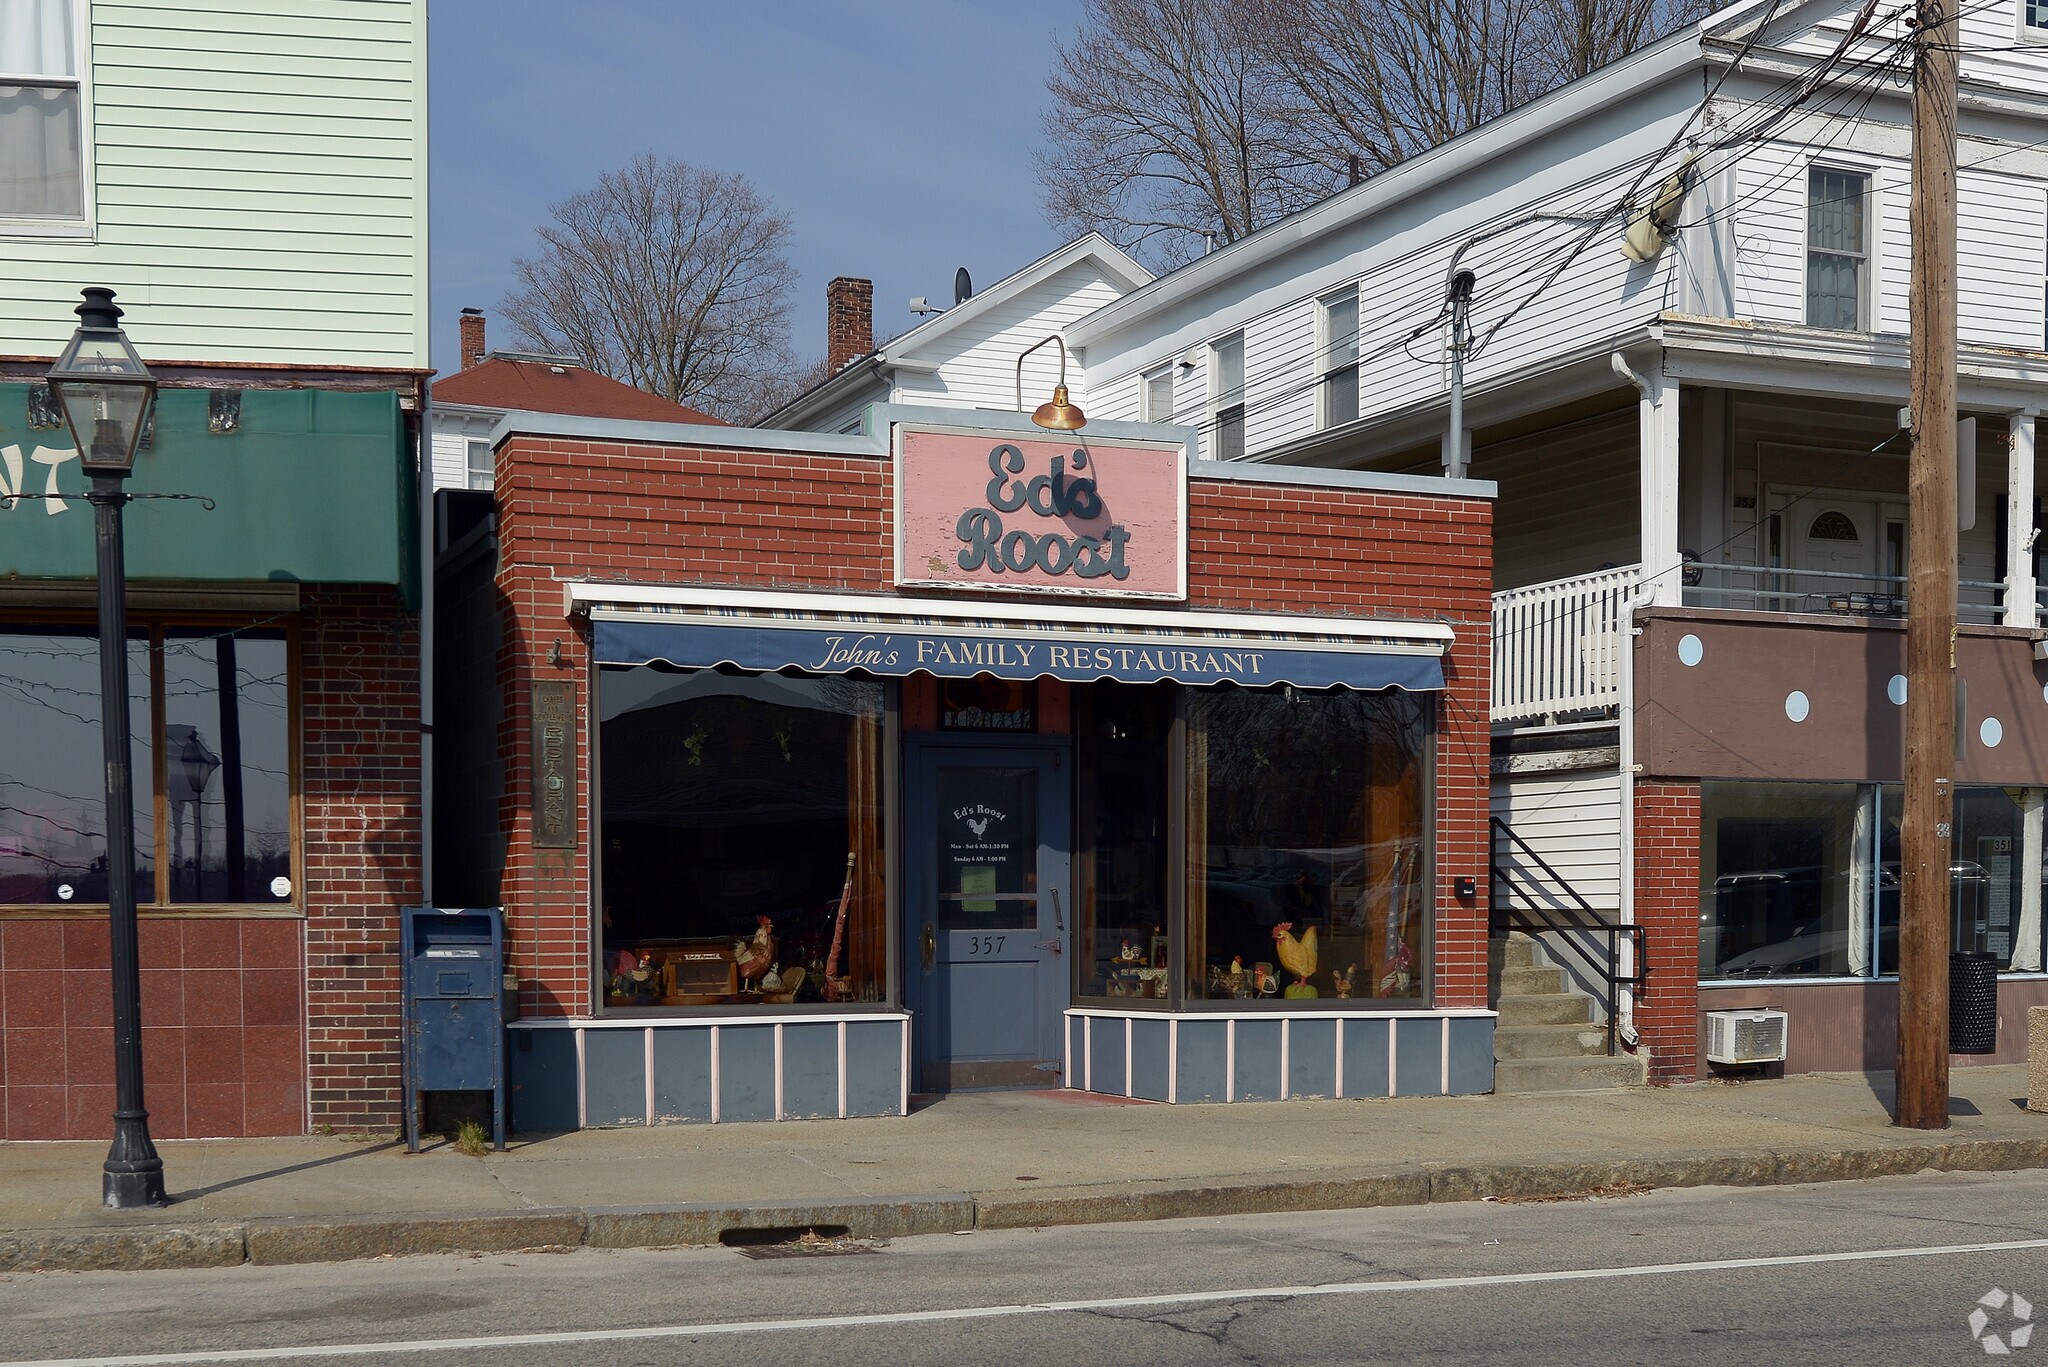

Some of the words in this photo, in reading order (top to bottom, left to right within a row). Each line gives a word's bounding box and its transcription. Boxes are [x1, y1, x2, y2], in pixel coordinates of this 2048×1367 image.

[986, 443, 1103, 520] Ed's
[955, 507, 1132, 580] Roost
[809, 635, 899, 670] John's
[916, 639, 1036, 668] FAMILY
[1049, 645, 1265, 674] RESTAURANT
[545, 726, 564, 834] RESTAURANT
[953, 805, 974, 821] Ed's
[977, 803, 1007, 822] Roost
[954, 855, 971, 863] Sunday
[1994, 839, 2011, 851] 351
[969, 935, 1006, 955] 357
